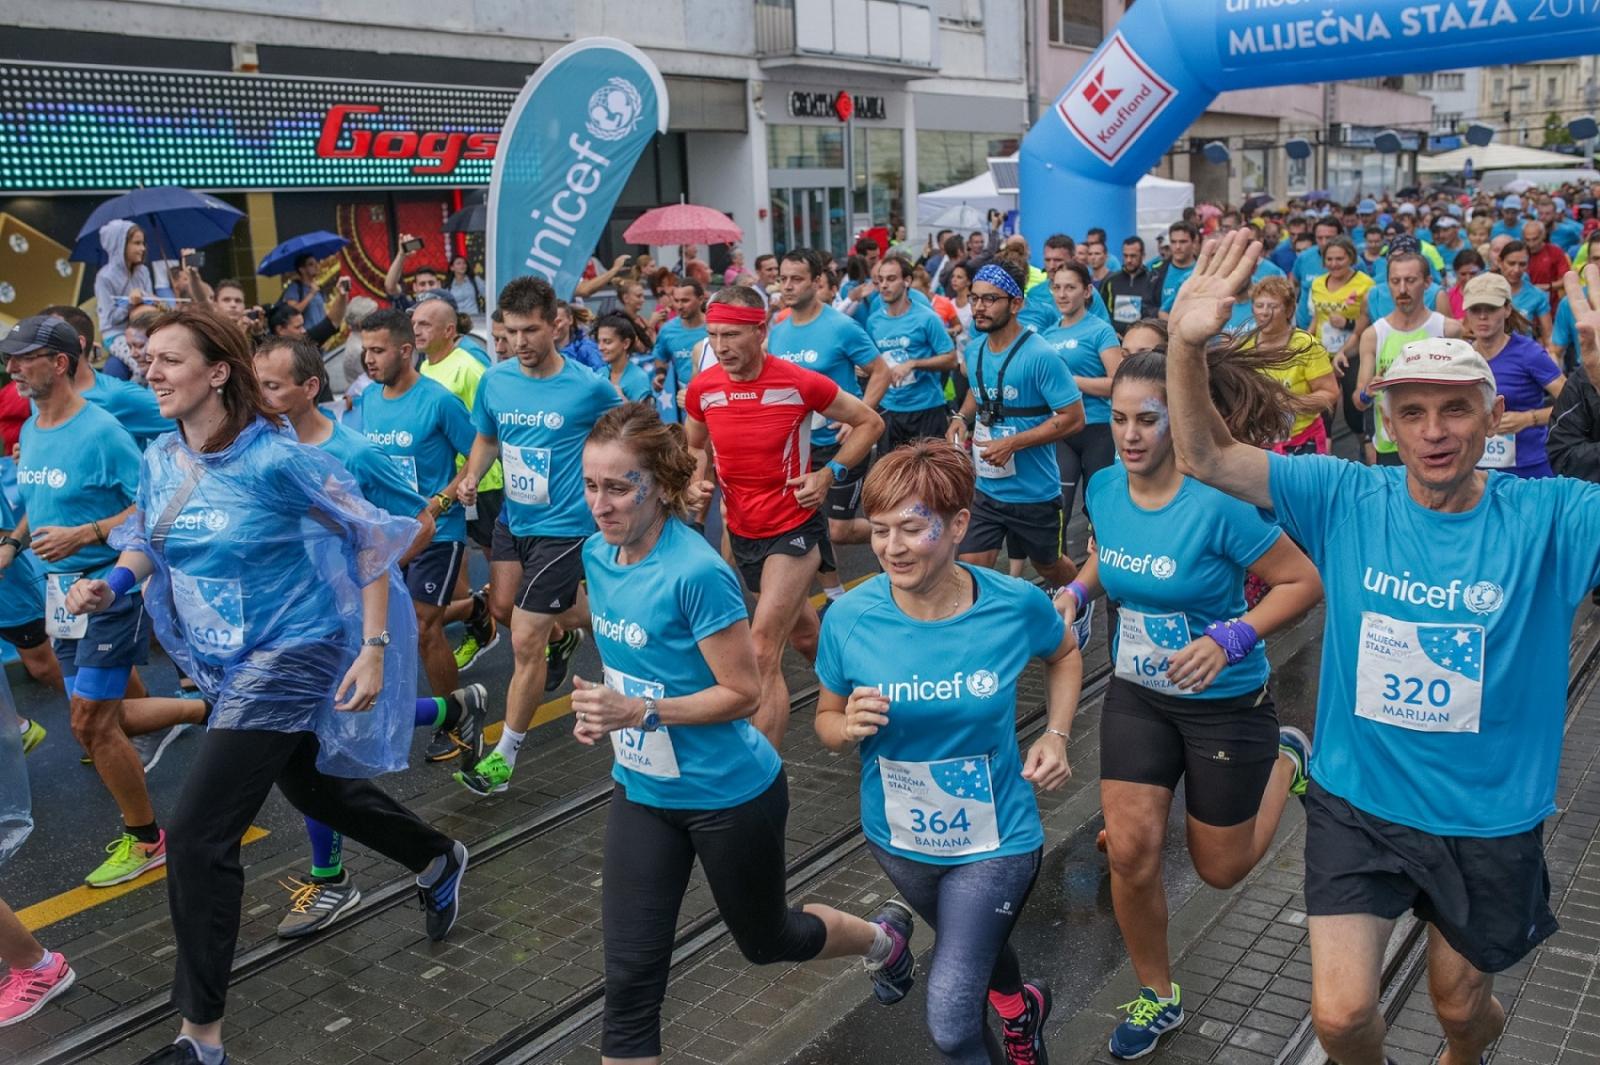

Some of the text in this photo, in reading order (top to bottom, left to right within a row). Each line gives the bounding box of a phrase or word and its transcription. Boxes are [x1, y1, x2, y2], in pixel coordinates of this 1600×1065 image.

[1229, 0, 1600, 56] MLIJEČNA STAZA 201
[1097, 83, 1152, 144] Kaufland
[1429, 353, 1452, 361] TOYS
[498, 409, 544, 427] unicef
[1486, 441, 1505, 455] 65
[17, 466, 48, 485] nicef
[511, 474, 535, 492] 501
[1100, 545, 1153, 575] unicef
[1363, 566, 1462, 611] unicef
[1133, 655, 1170, 678] 164
[877, 672, 963, 702] unicef
[1382, 673, 1451, 707] 320
[1382, 704, 1450, 723] MARIJAN
[619, 749, 653, 767] VLATKA
[910, 807, 972, 834] 364
[914, 836, 972, 850] BANANA
